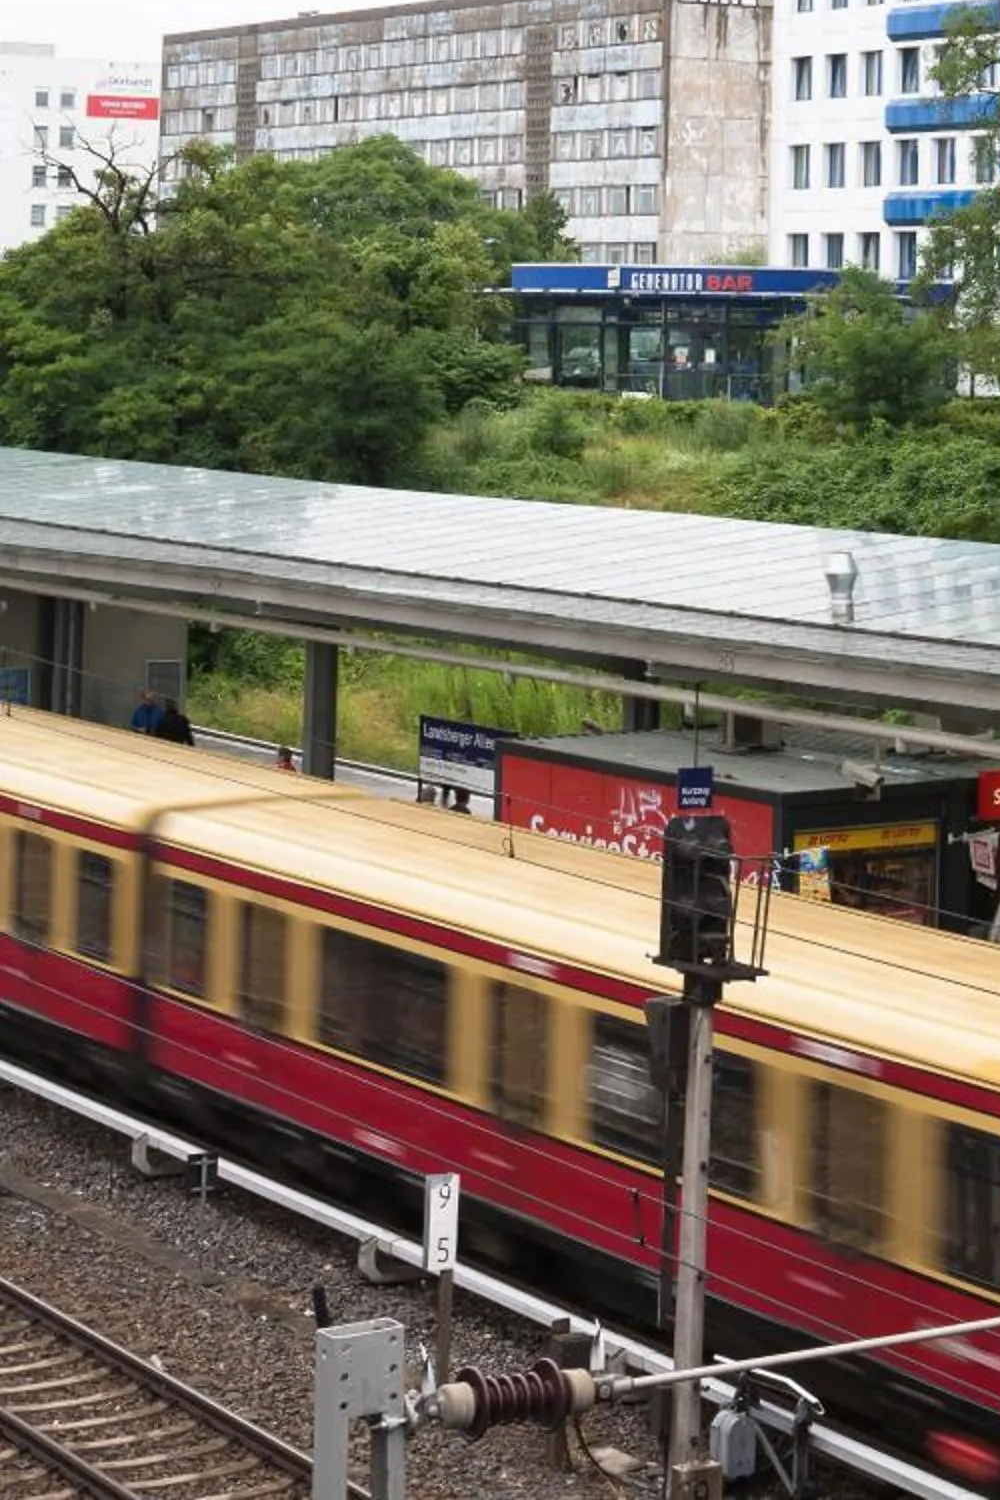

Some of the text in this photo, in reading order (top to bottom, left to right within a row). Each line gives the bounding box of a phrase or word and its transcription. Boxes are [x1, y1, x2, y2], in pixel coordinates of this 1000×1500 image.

[631, 273, 754, 291] GENERATOR BAR
[439, 1183, 451, 1209] 9
[437, 1237, 449, 1263] 5
